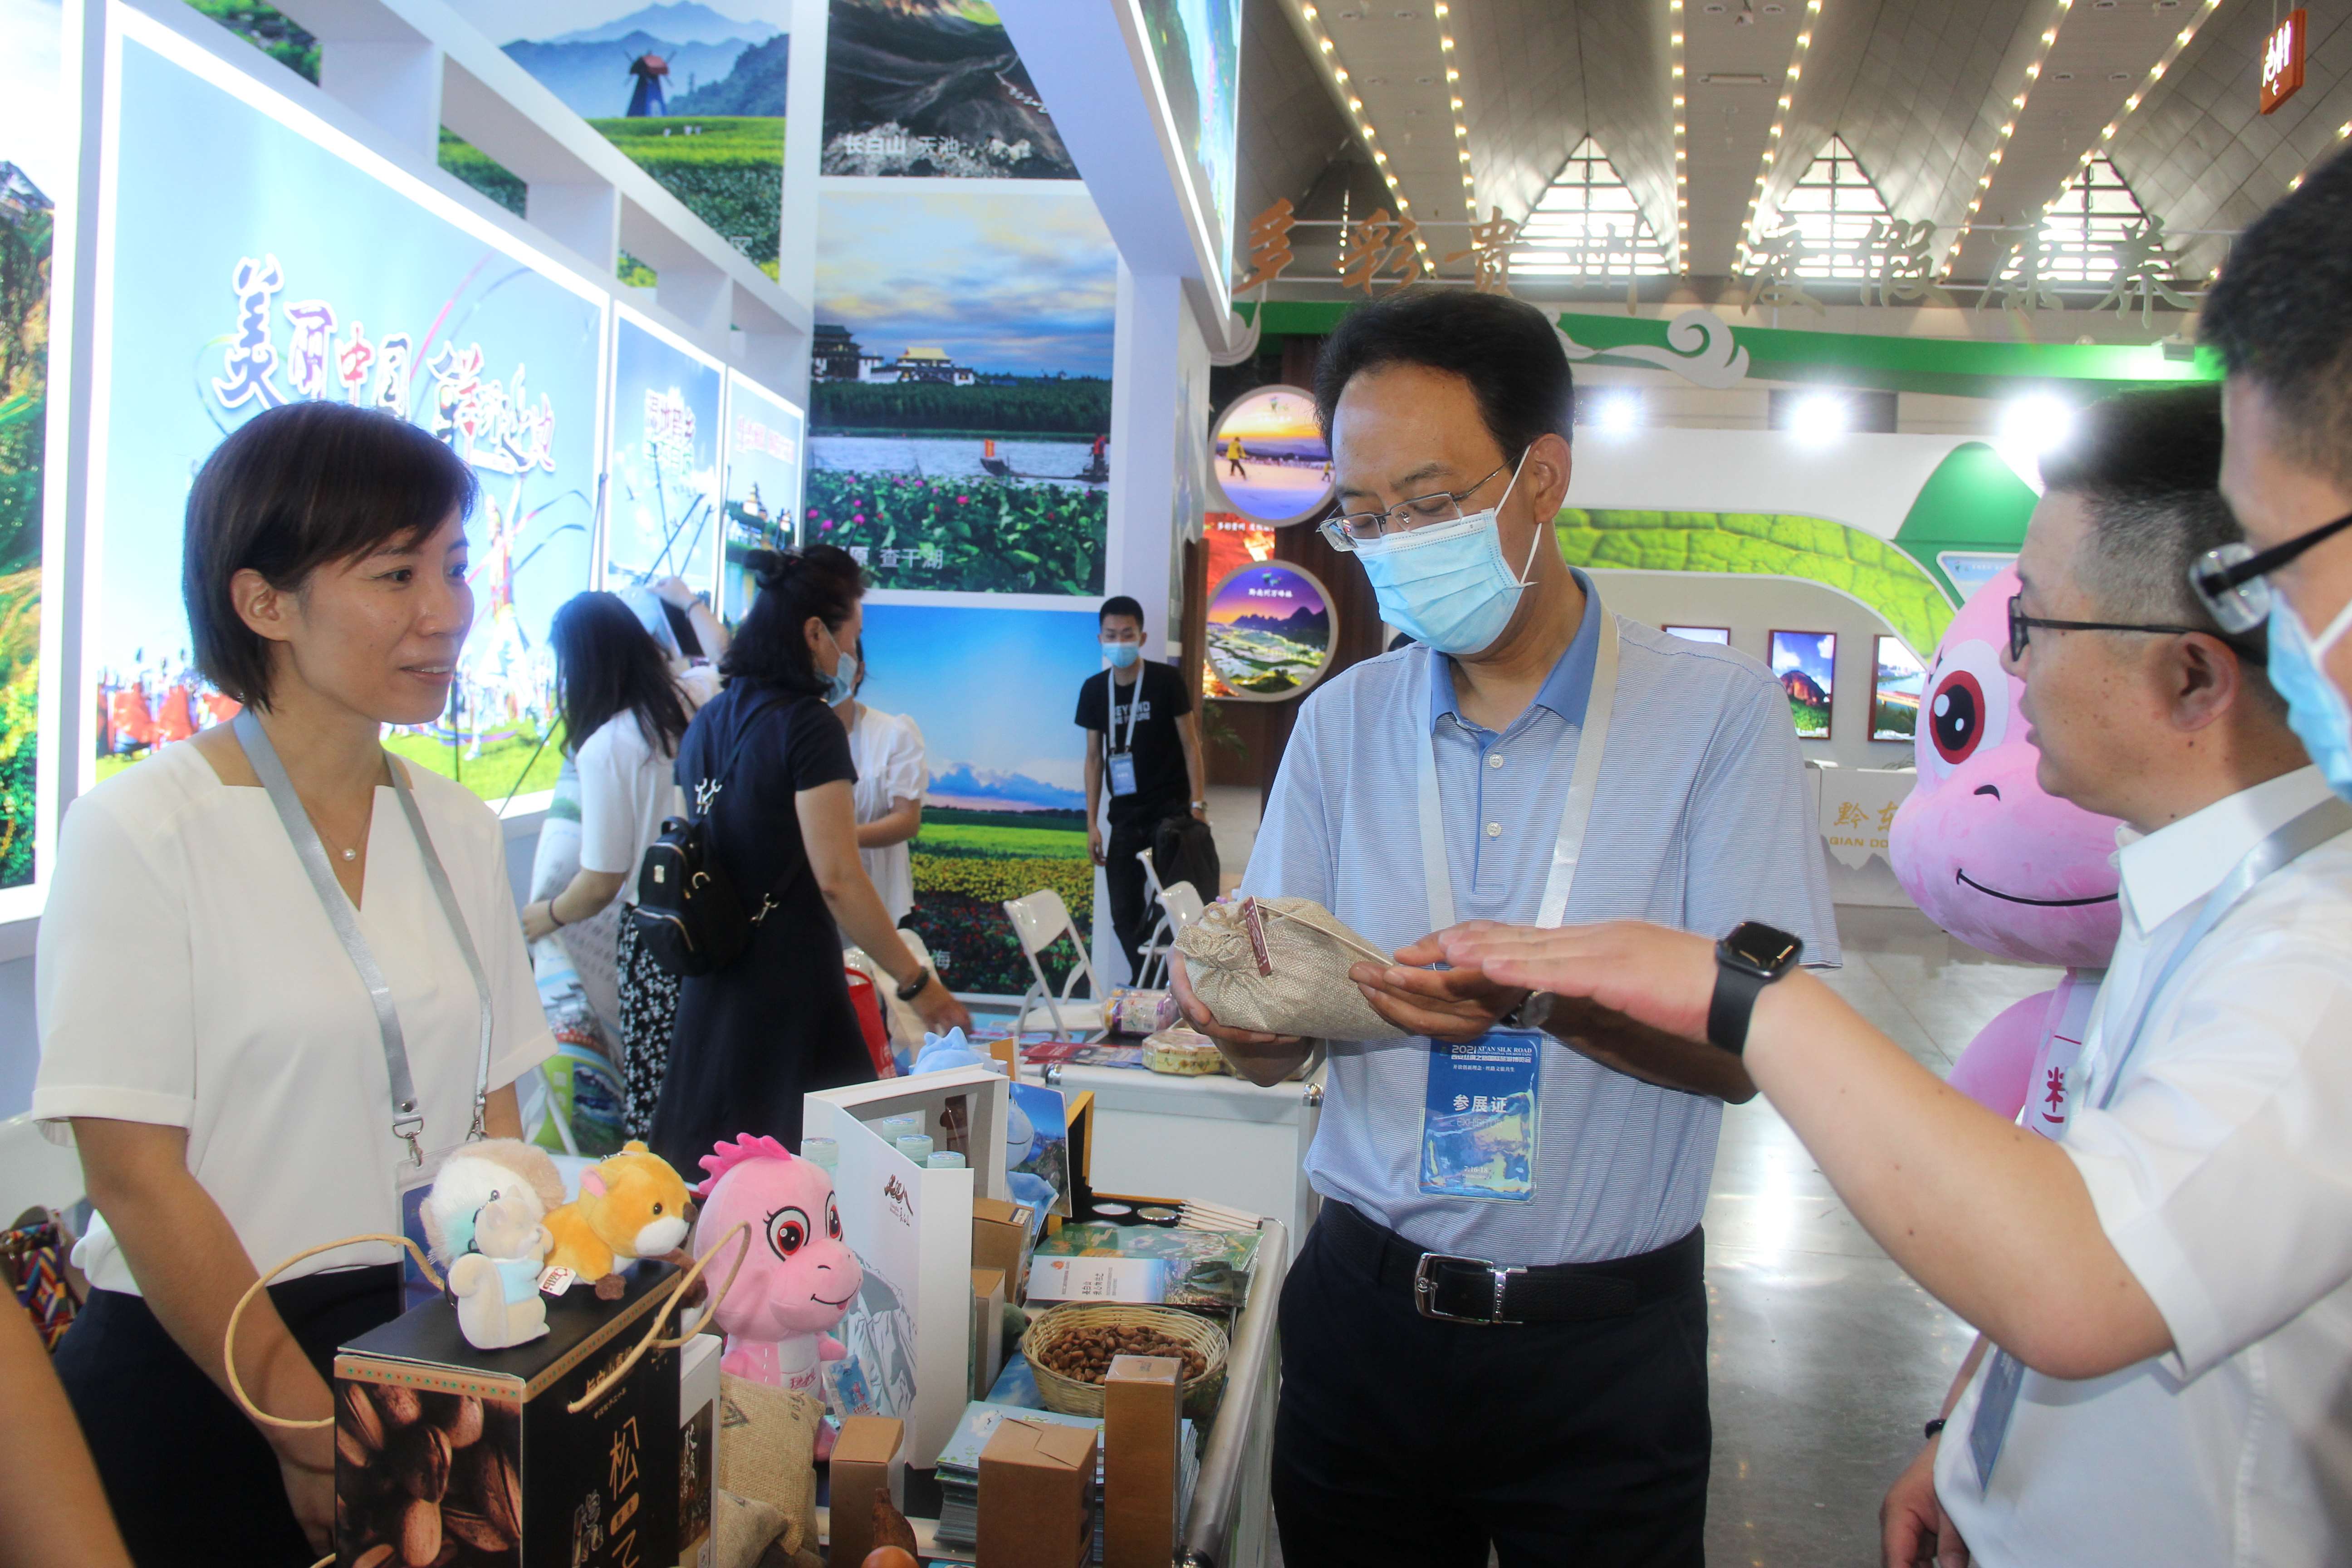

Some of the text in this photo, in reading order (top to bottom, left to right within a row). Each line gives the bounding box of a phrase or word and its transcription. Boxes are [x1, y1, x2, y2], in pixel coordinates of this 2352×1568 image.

[844, 134, 960, 157] 长白山 天池
[880, 547, 944, 570] 查干湖
[1829, 837, 1864, 847] QIAN
[1451, 1045, 1476, 1054] 2021
[1453, 1094, 1508, 1113] 参展证
[1456, 1117, 1503, 1128] EXHIBITOR
[1464, 1165, 1489, 1173] 7.16-18
